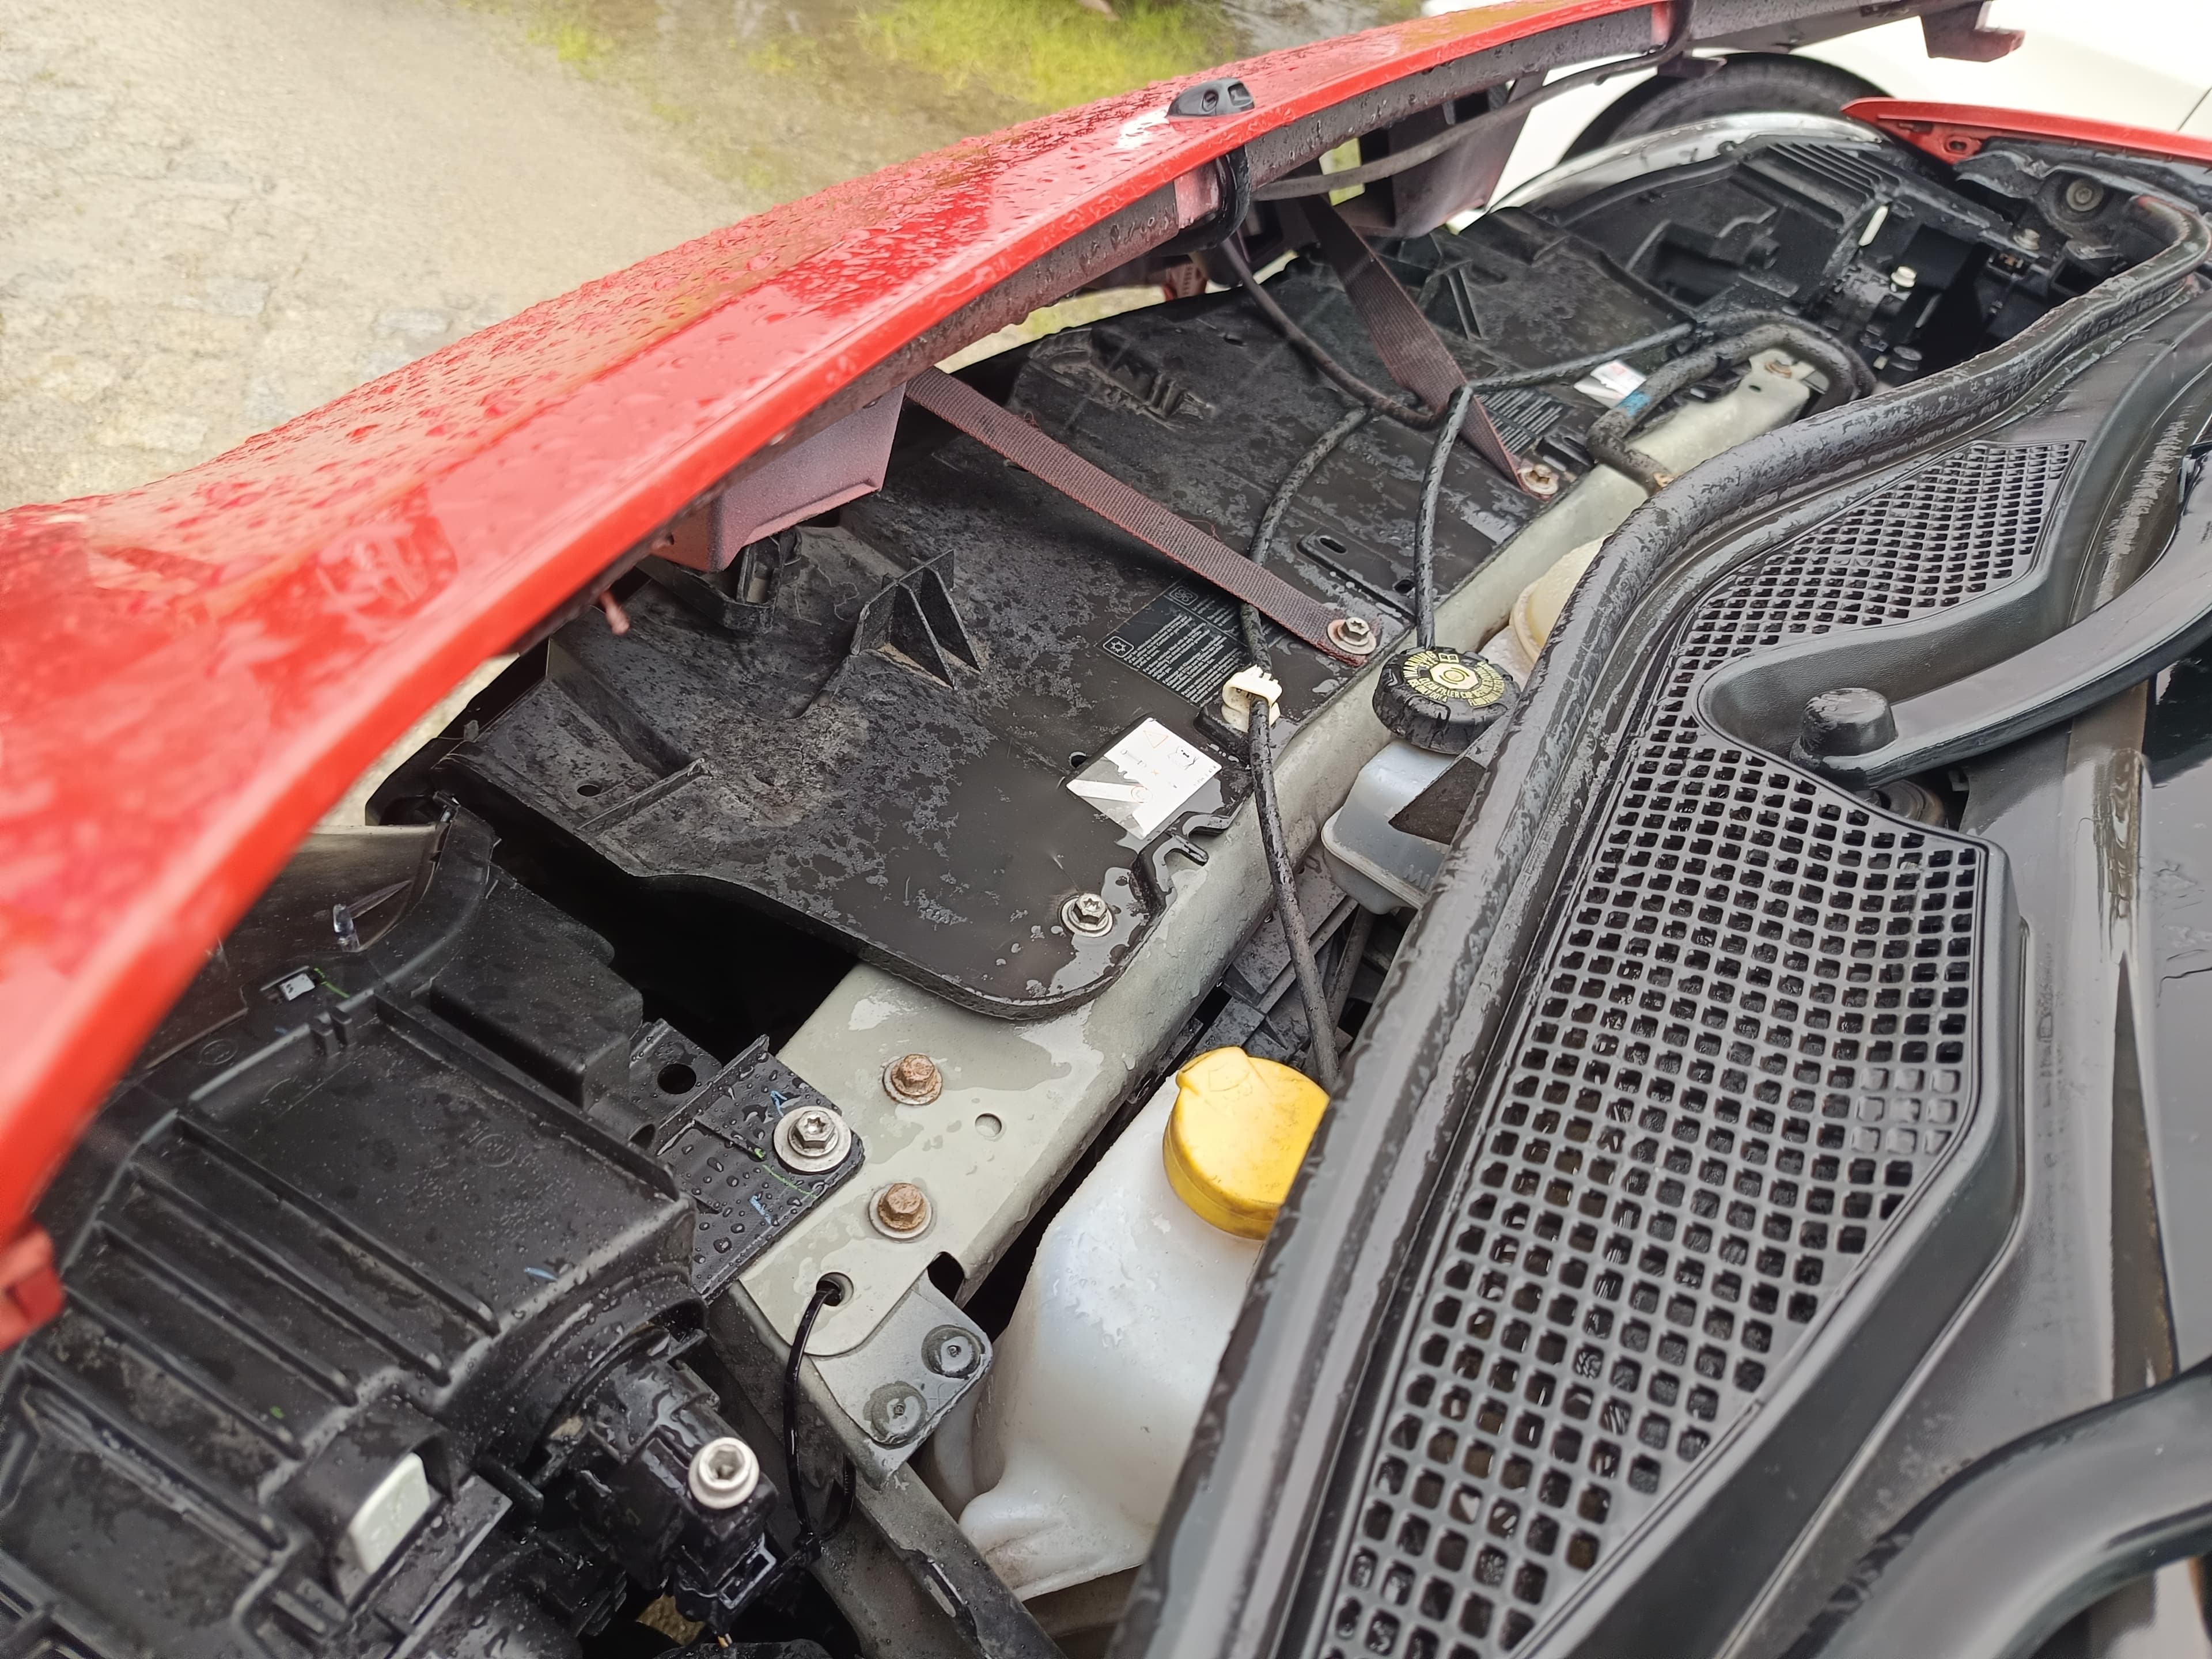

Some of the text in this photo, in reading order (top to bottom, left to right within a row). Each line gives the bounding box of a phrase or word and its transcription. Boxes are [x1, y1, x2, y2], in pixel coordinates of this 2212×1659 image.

[1403, 650, 1436, 678] WARNING
[1429, 691, 1442, 700] DOT
[1437, 686, 1460, 699] FILLER
